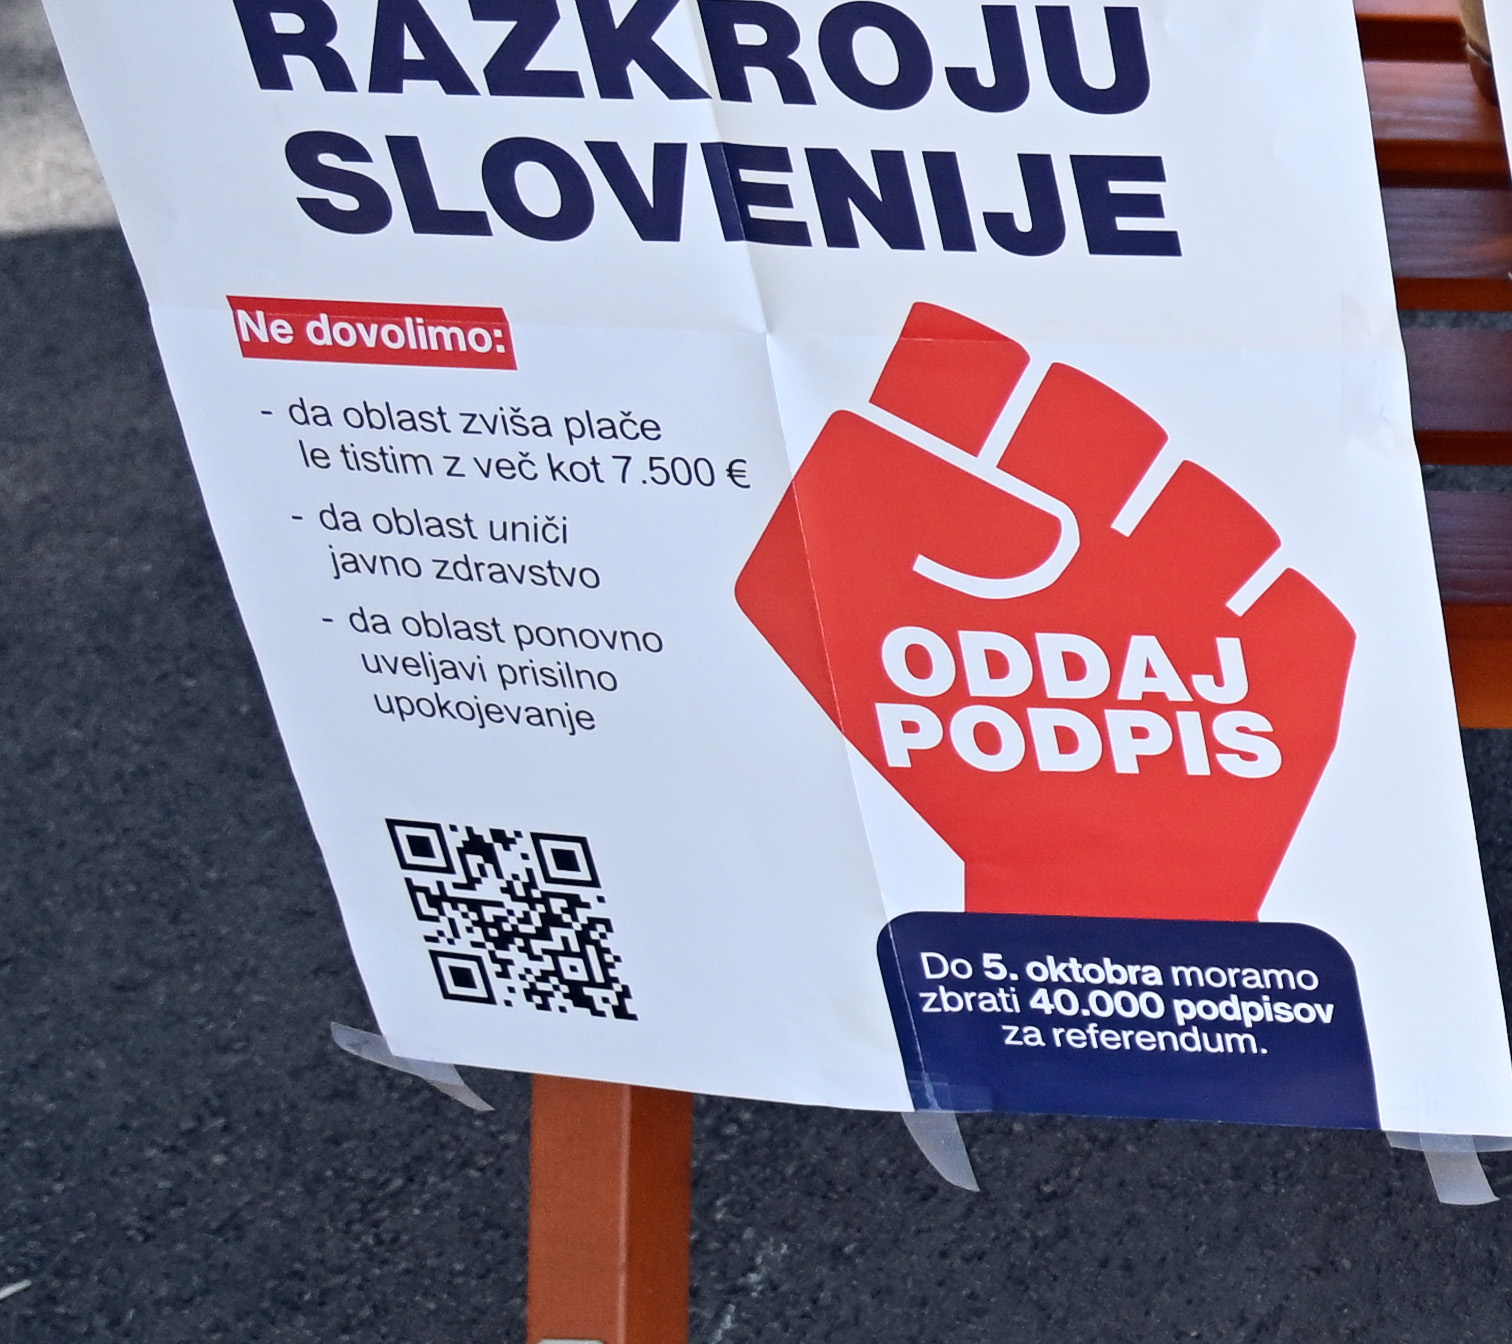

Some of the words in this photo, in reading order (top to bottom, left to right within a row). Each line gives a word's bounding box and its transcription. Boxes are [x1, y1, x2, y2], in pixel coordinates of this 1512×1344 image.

[285, 131, 1181, 256] SLOVENIJE
[237, 310, 293, 344] Ne
[306, 314, 505, 353] dovolimo:
[882, 627, 1248, 704] ODDAJ
[875, 703, 1281, 778] PODPIS
[921, 952, 972, 979] Do
[983, 953, 1018, 980] 5.
[1026, 956, 1163, 985] oktobra
[1171, 966, 1318, 990] moramo
[919, 985, 1020, 1013] zbrati
[1030, 988, 1164, 1018] 40.000
[1173, 994, 1334, 1027] podpisov
[1002, 1025, 1045, 1046] za
[1053, 1023, 1267, 1054] referendum.
